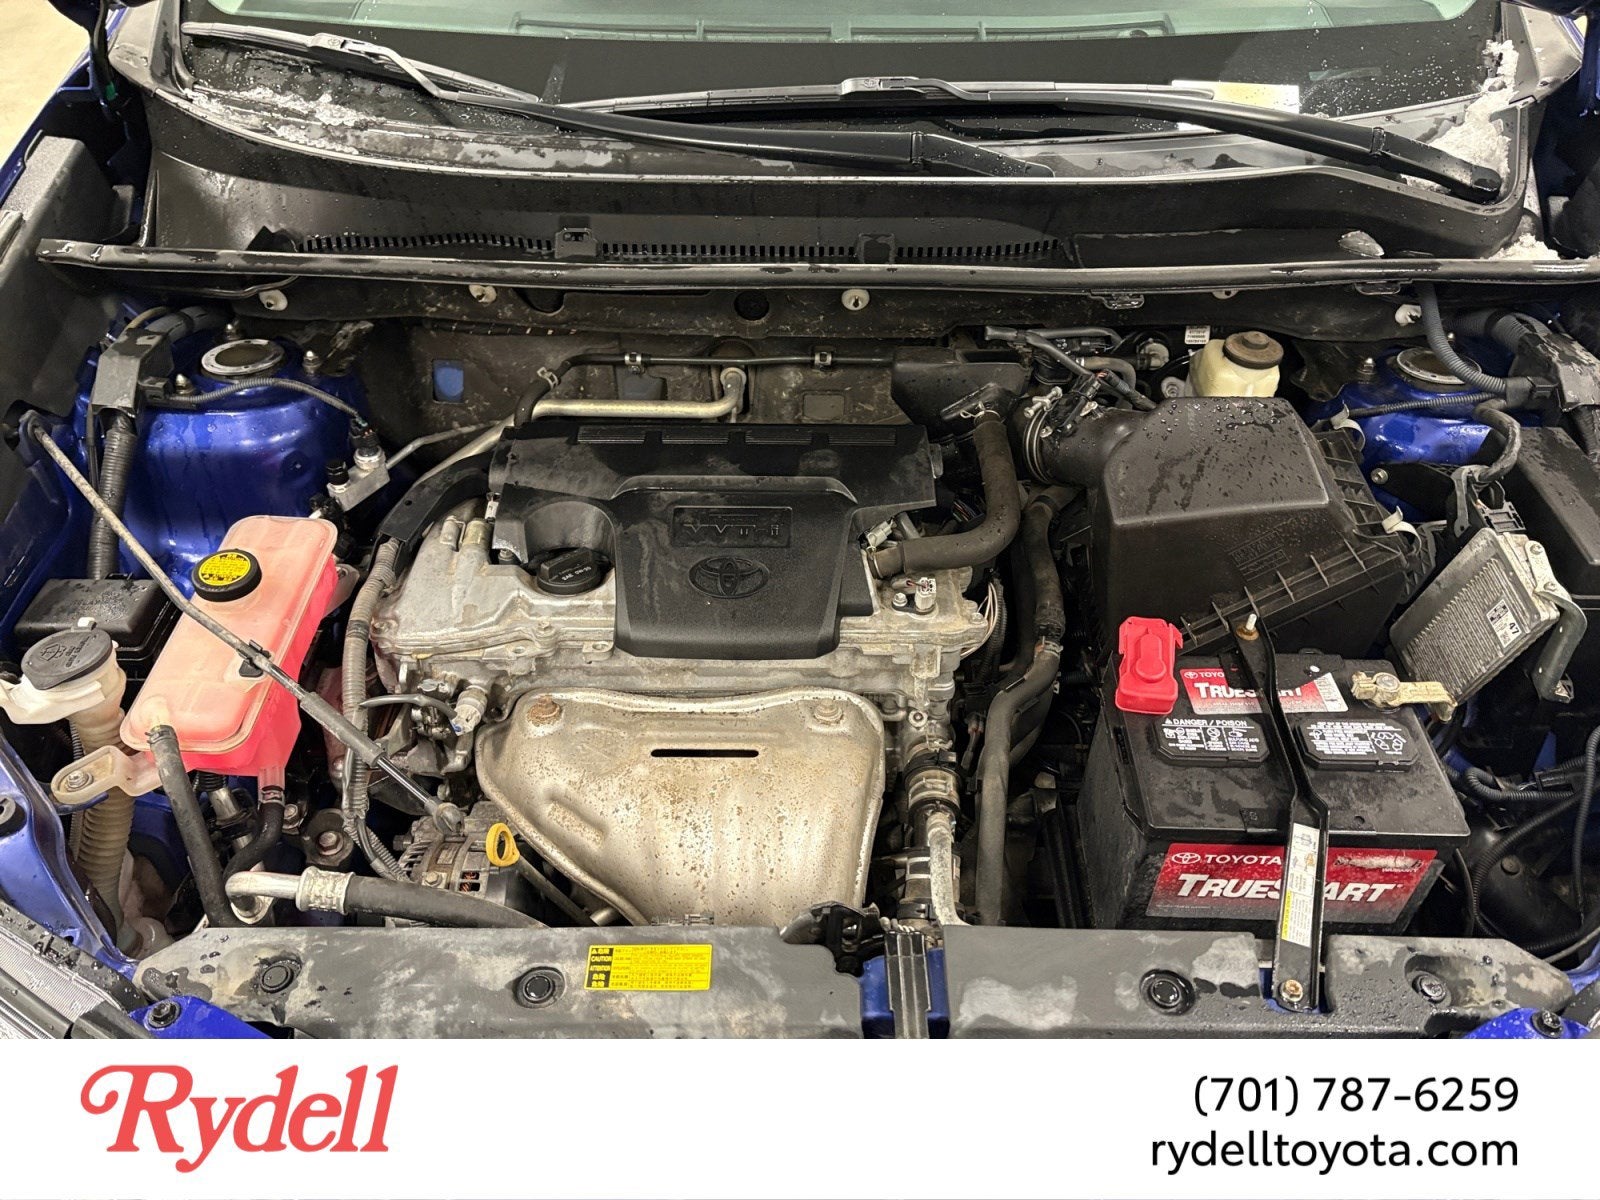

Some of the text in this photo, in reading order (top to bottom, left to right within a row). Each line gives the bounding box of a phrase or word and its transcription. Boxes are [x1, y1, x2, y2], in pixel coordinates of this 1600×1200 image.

[1173, 718, 1208, 726] DANGER
[1216, 719, 1248, 727] POISON
[1205, 853, 1282, 865] TOYOTA
